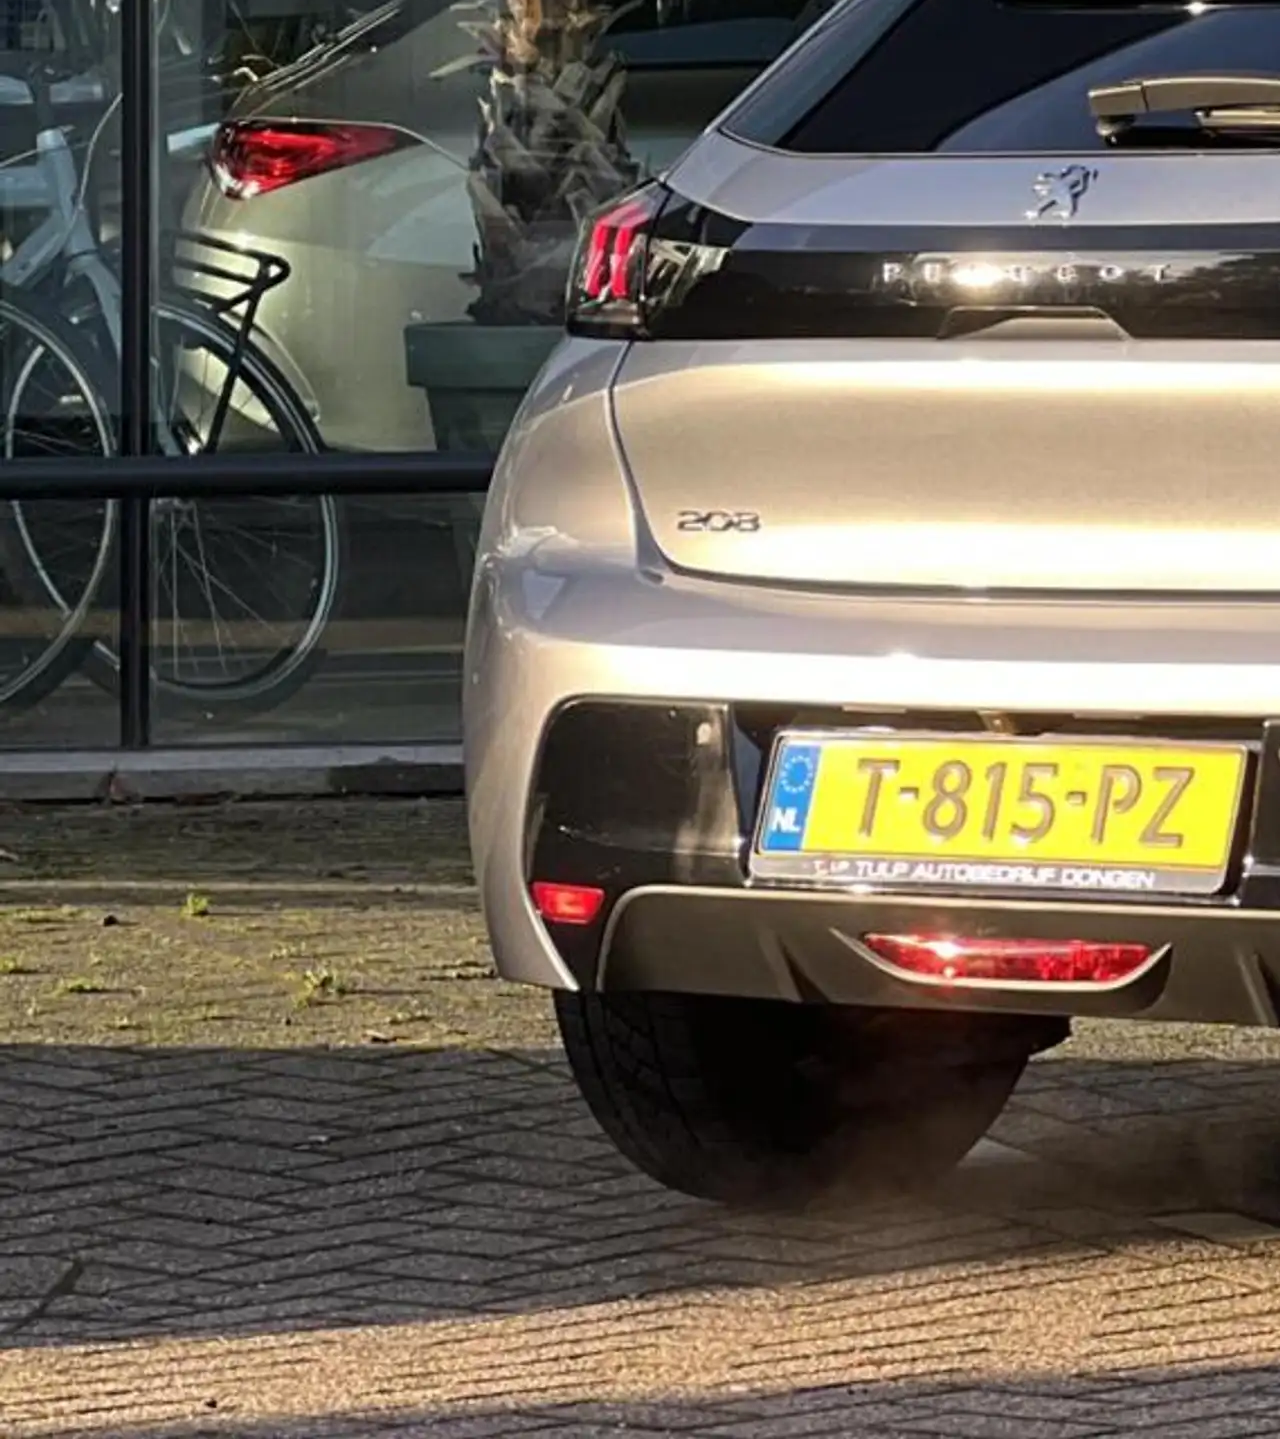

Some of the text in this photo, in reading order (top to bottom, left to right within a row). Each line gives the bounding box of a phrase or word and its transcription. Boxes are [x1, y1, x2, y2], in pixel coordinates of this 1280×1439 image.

[676, 511, 762, 532] 208
[857, 757, 1196, 848] T-815-PZ
[771, 807, 800, 834] NL
[855, 861, 1156, 889] TULP AUTOBEDRIJF DONGEN
